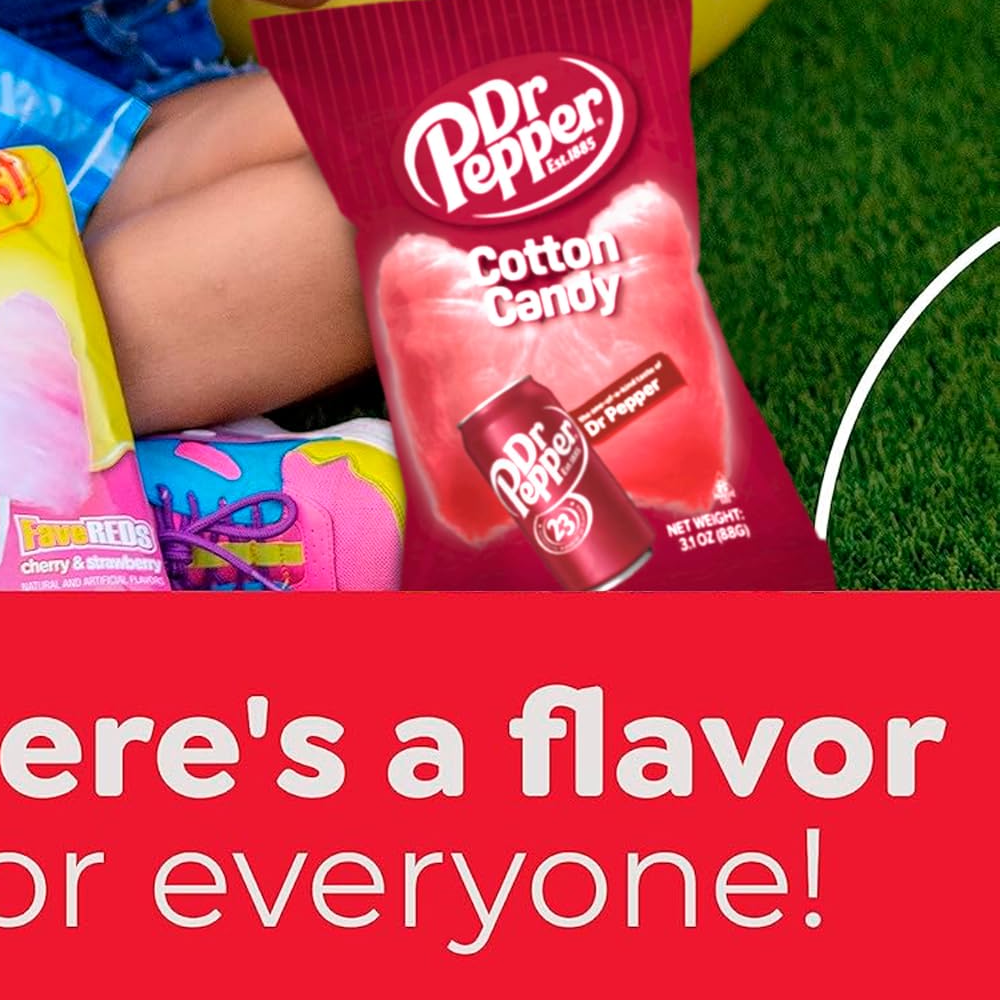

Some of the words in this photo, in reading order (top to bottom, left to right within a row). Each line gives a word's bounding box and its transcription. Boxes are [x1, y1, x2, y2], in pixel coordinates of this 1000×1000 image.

[468, 75, 548, 146] Dr
[404, 87, 603, 213] Pepper
[468, 231, 621, 286] Cotton
[483, 270, 621, 327] Candy
[584, 415, 607, 437] Dr
[604, 378, 661, 423] Pepper
[490, 419, 576, 519] Pepper
[503, 421, 546, 475] Dr
[547, 513, 576, 542] 23
[666, 519, 691, 538] NET
[692, 508, 746, 530] WEIGHT:
[715, 523, 752, 544] (88G)
[20, 580, 61, 592] NATURAL
[62, 578, 82, 588] AND
[82, 576, 127, 587] ARTIFICIAL
[21, 557, 70, 575] cherry
[72, 555, 85, 570] &
[85, 554, 162, 574] strawberry
